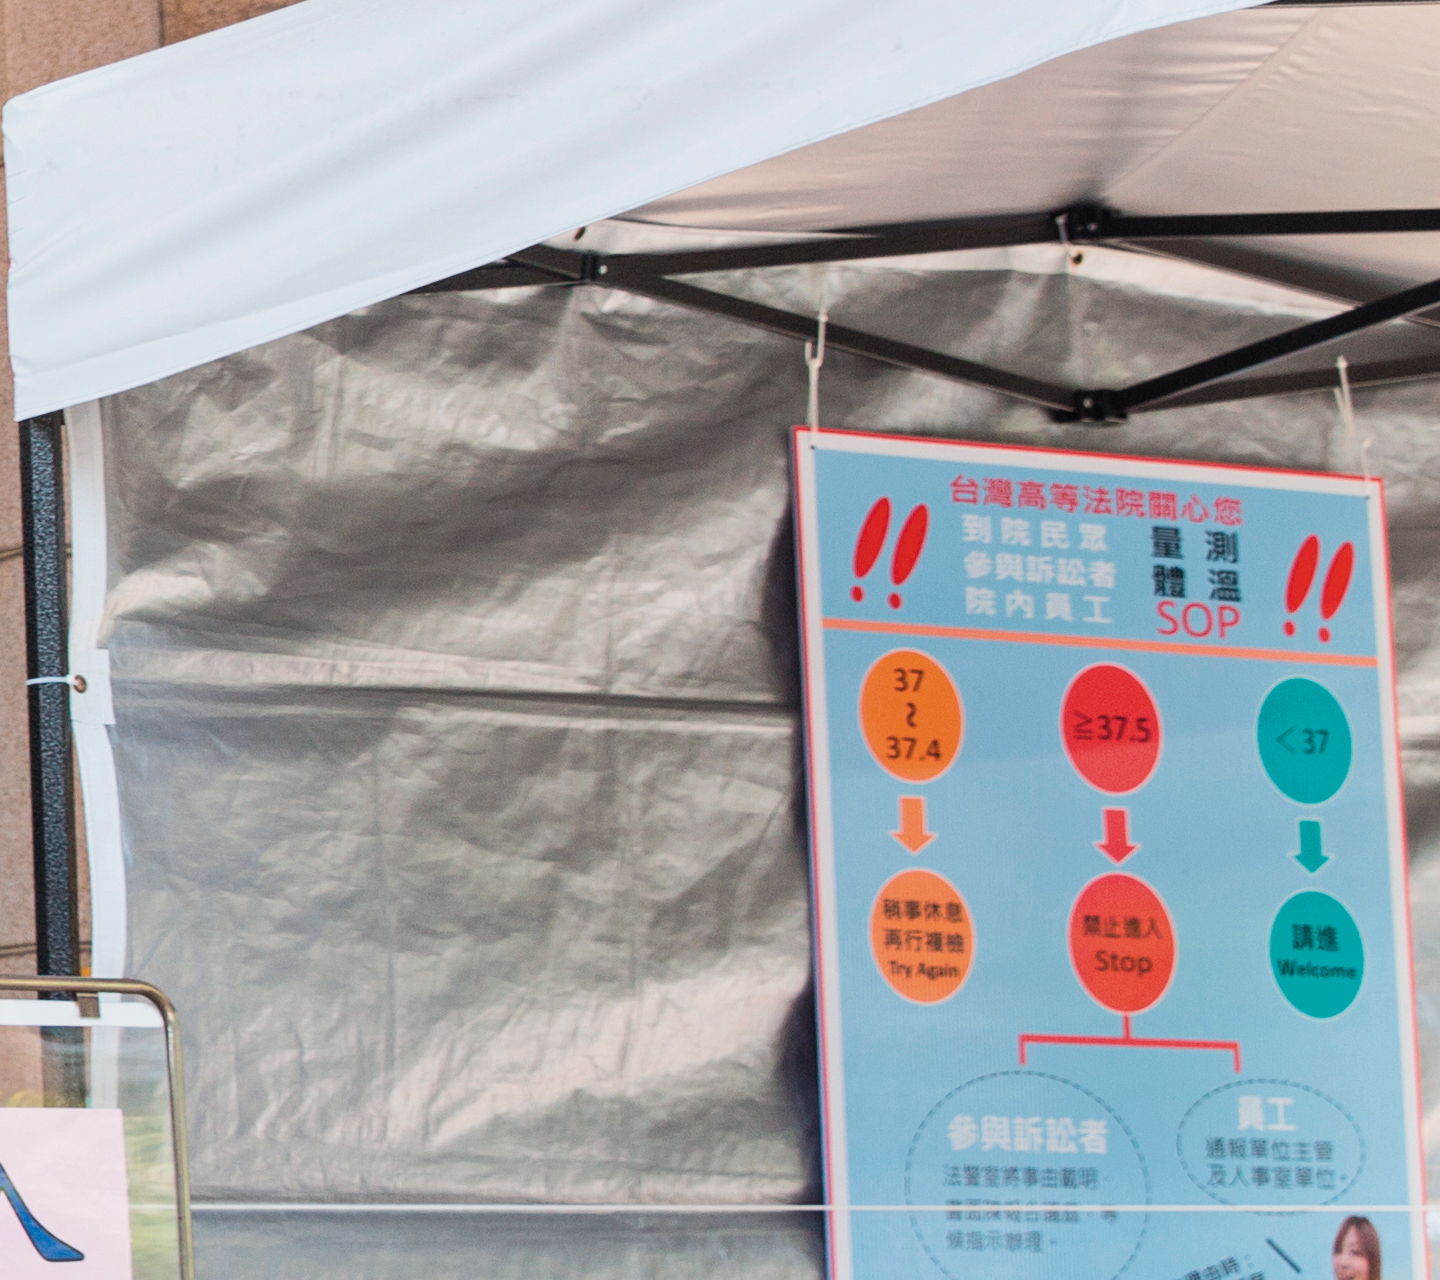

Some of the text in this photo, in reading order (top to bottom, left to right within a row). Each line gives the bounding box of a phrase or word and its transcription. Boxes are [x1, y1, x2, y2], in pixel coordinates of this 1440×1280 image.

[949, 474, 1244, 527] 台灣高等法院關心您
[961, 514, 1109, 552] 到院民眾
[1151, 525, 1240, 564] 量測
[963, 550, 1116, 589] 參與訴訟者
[1152, 564, 1241, 603] 體溫
[964, 586, 1114, 624] 院內員工
[1156, 600, 1242, 639] SOP
[893, 668, 924, 693] 37
[885, 736, 942, 762] 37.4
[1083, 915, 1163, 939] 禁止進入
[1291, 923, 1340, 952] 請進
[888, 960, 959, 980] Try Again
[1094, 950, 1154, 977] Stop
[1276, 958, 1358, 980] Welcome
[1237, 1095, 1297, 1133] 員工
[948, 1113, 1108, 1155] 參與訴訟者
